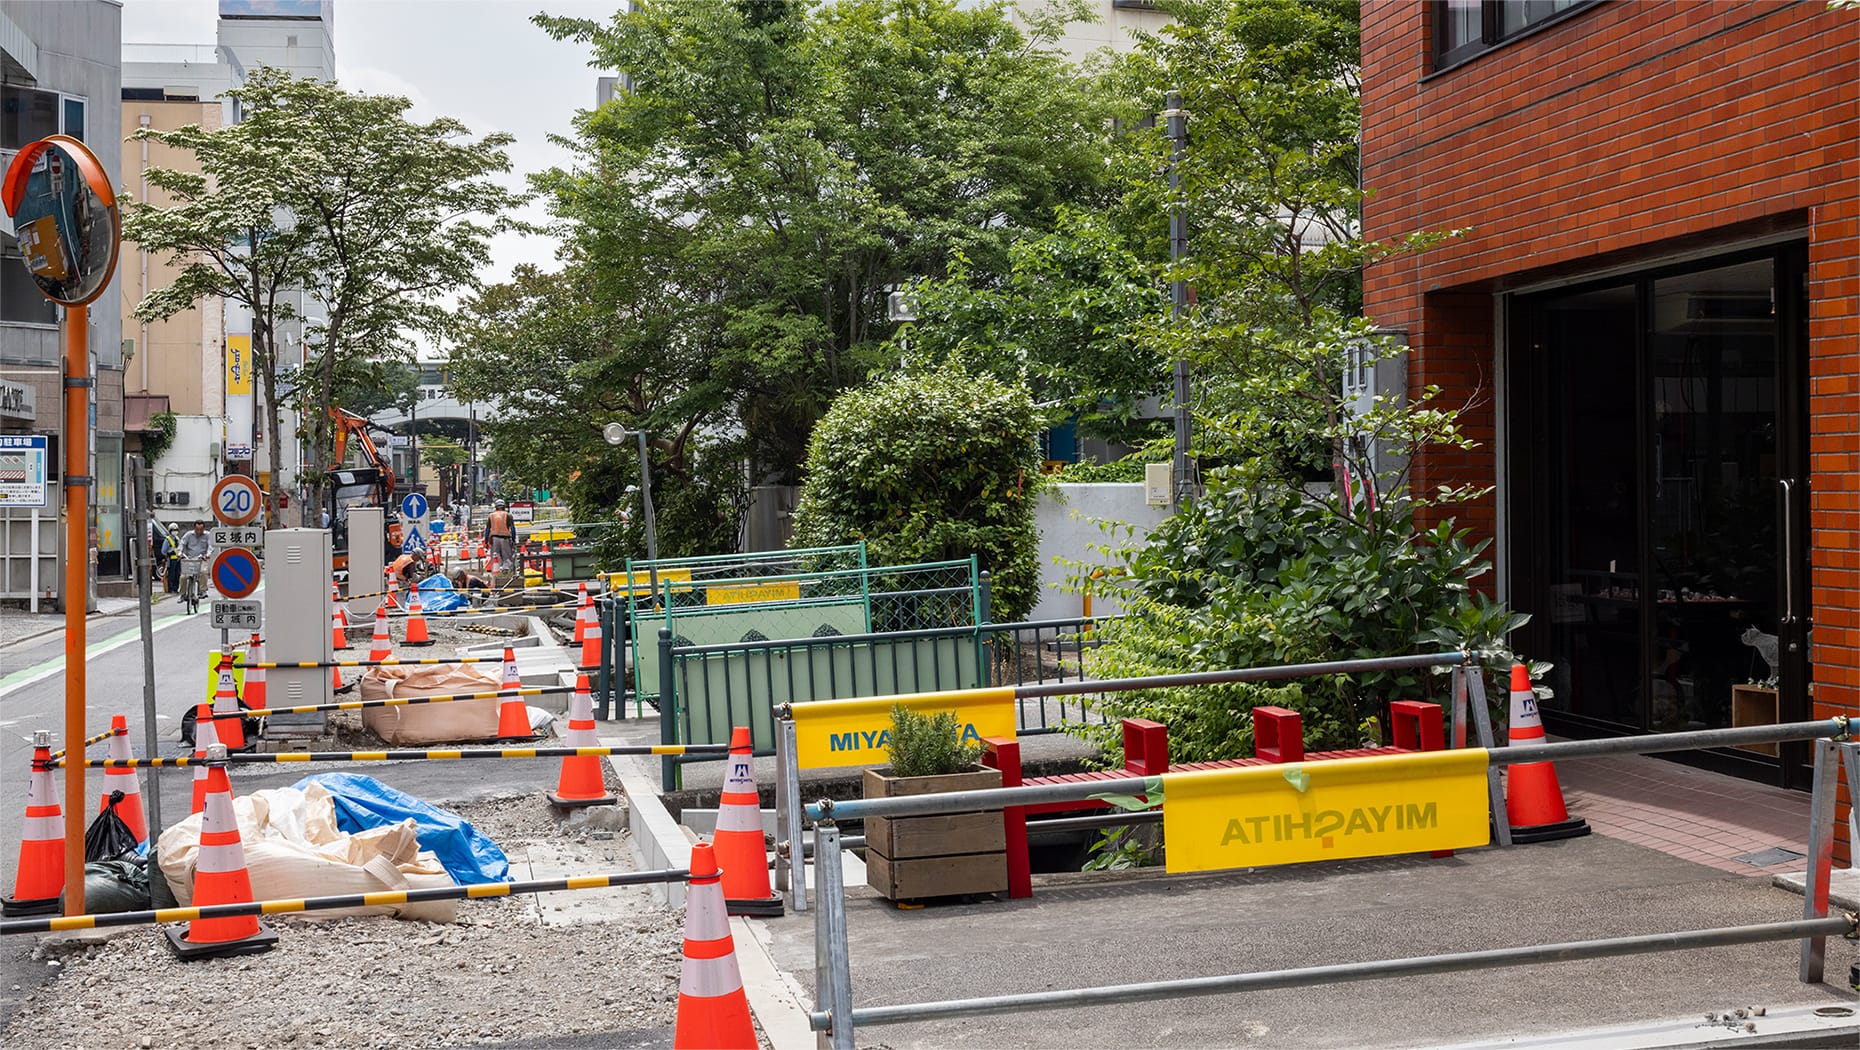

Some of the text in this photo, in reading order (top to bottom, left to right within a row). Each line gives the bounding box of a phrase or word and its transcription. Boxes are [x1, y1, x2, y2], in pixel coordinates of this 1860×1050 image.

[222, 489, 251, 512] 20
[215, 531, 256, 544] 区域内
[215, 615, 256, 624] 区域内
